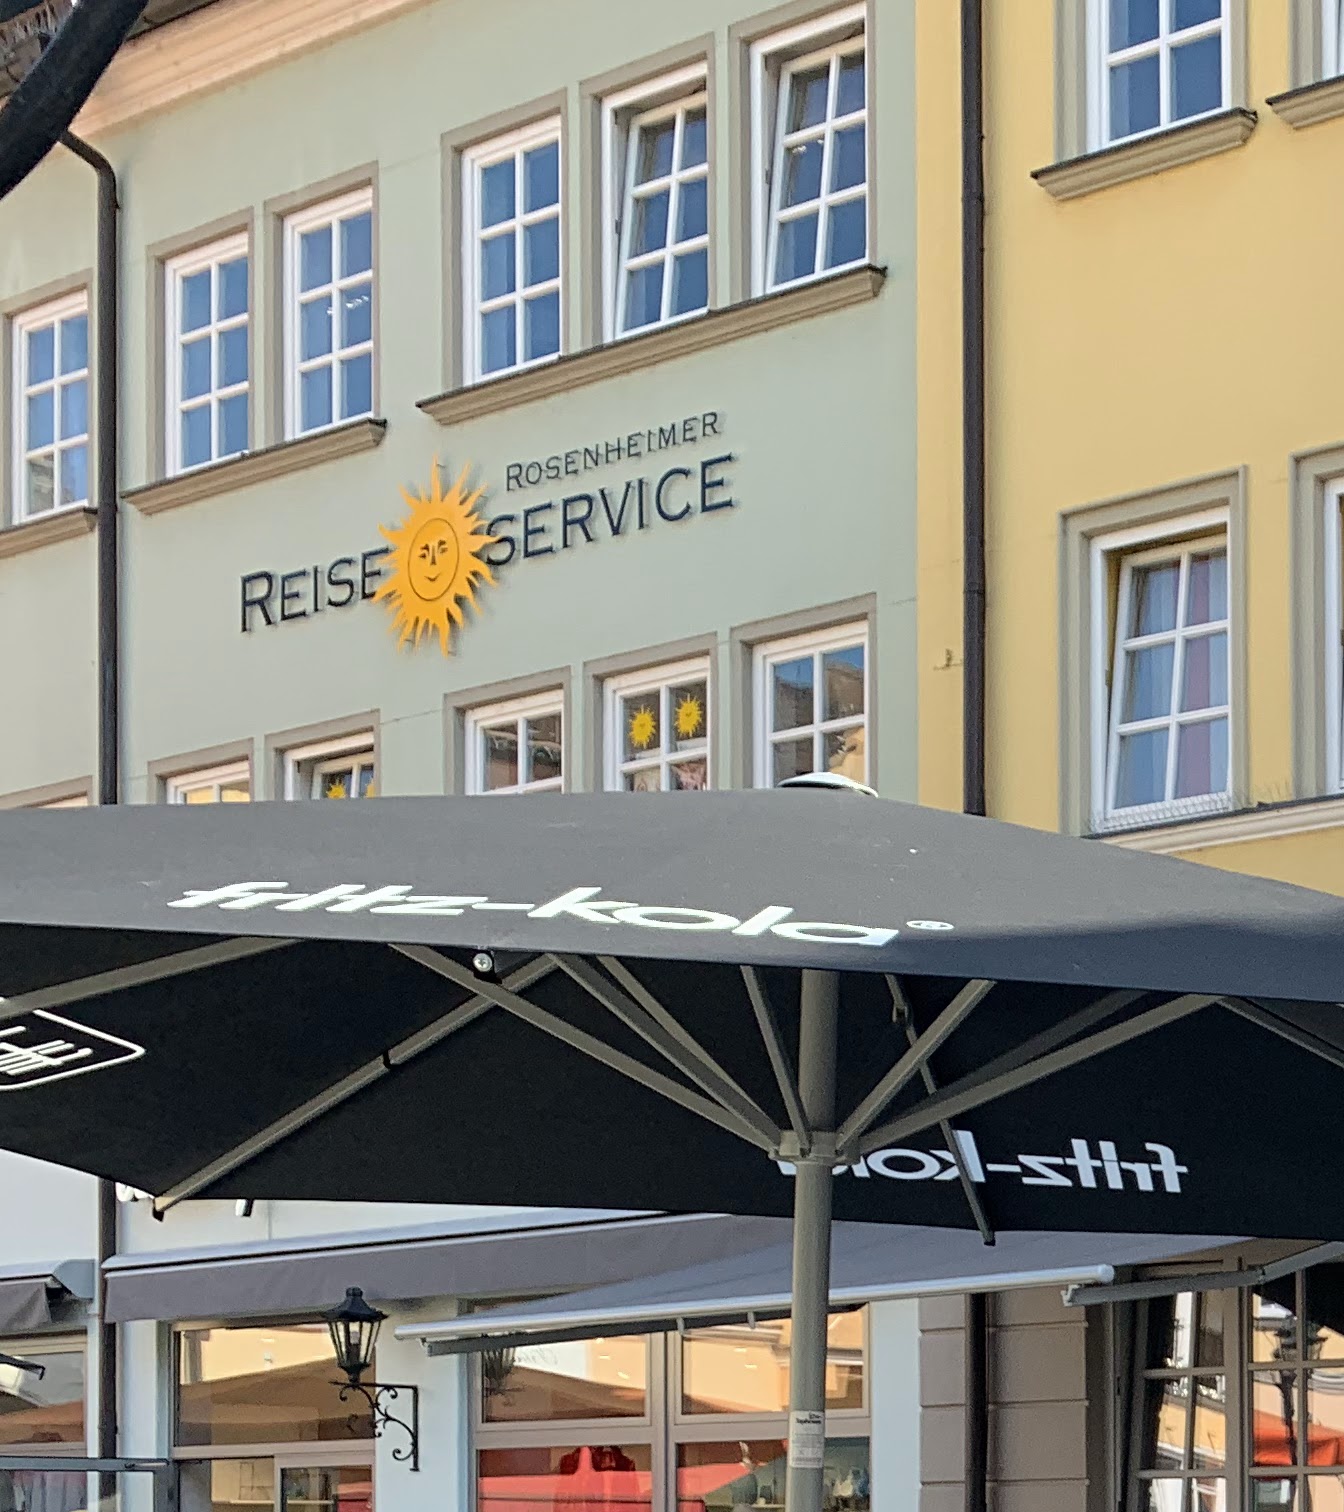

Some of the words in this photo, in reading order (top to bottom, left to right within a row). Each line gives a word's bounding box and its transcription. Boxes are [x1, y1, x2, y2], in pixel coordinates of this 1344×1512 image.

[505, 410, 720, 492] ROSENHEIMER
[240, 545, 392, 633] REISE
[485, 452, 736, 568] SERVICE
